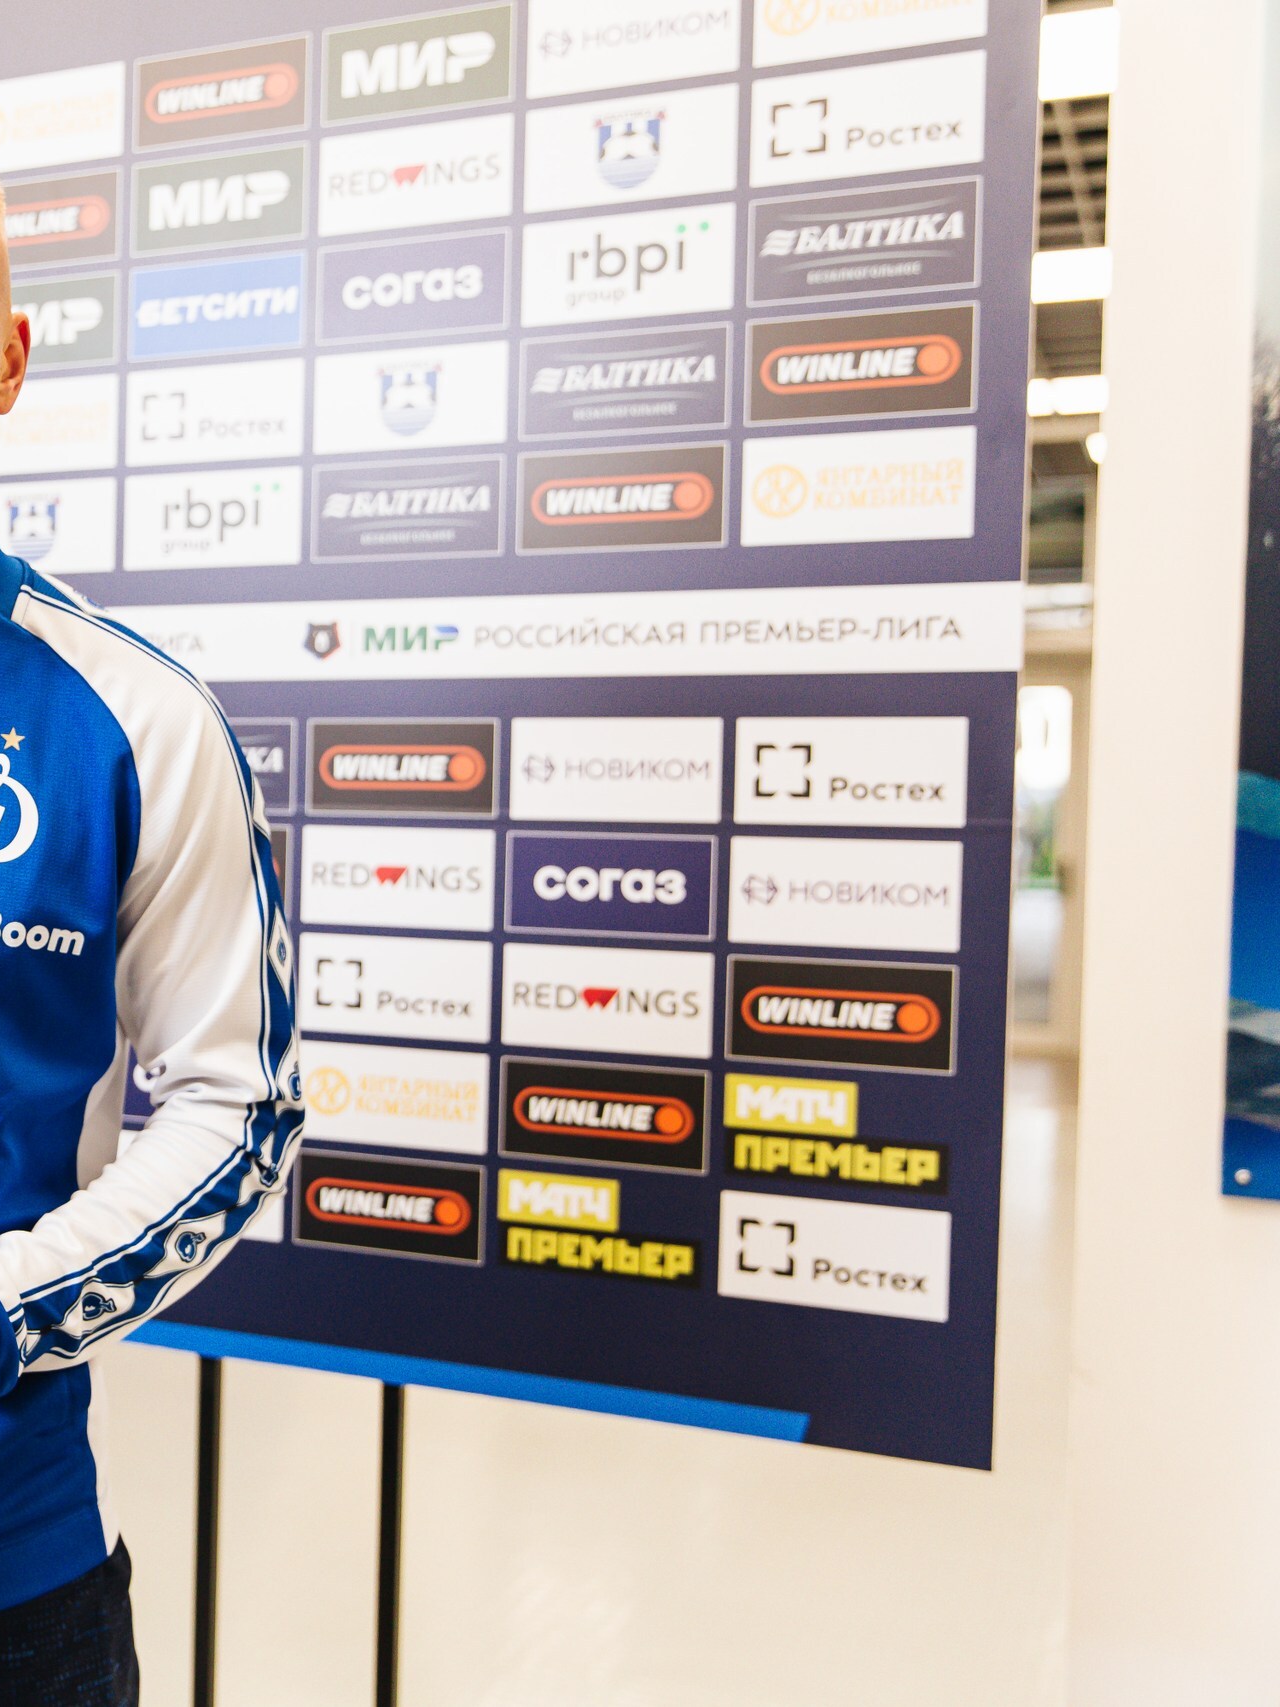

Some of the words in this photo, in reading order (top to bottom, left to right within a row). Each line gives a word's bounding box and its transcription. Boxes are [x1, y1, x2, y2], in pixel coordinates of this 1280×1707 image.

[581, 10, 732, 51] НОВИКОМ
[340, 31, 495, 99] МИР
[155, 75, 265, 115] WINLINE
[846, 118, 962, 150] Ростех
[148, 169, 290, 231] МИР
[6, 206, 79, 236] NLINE
[793, 210, 964, 255] БАЛТИКА
[567, 220, 711, 292] rbpi
[13, 298, 102, 345] ИР
[560, 355, 715, 391] БАЛТИКА
[776, 347, 917, 384] WINLINE
[198, 417, 286, 439] Ростех
[162, 482, 282, 542] rbpi
[349, 486, 490, 516] БАЛТИКА
[546, 483, 674, 516] WINLINE
[363, 626, 459, 653] МИР
[474, 620, 685, 648] РОССИЙСКАЯ
[700, 616, 962, 647] ПРЕМЬЕР-ЛИГА
[332, 754, 449, 781] WINLINE
[565, 757, 712, 781] НОВИКОМ
[830, 777, 945, 802] Ростех
[788, 880, 948, 908] НОВИКОМ
[376, 992, 472, 1017] Ростех
[756, 995, 896, 1032] WINLINE
[526, 1095, 654, 1132] WINLINE
[735, 1083, 849, 1126] МАТЧ
[735, 1135, 940, 1185] ПРЕМЬЕР
[318, 1186, 436, 1224] WINLINE
[508, 1178, 612, 1223] МАТЧ
[508, 1227, 694, 1279] ПРЕМЬЕР
[811, 1258, 927, 1293] Ростех
